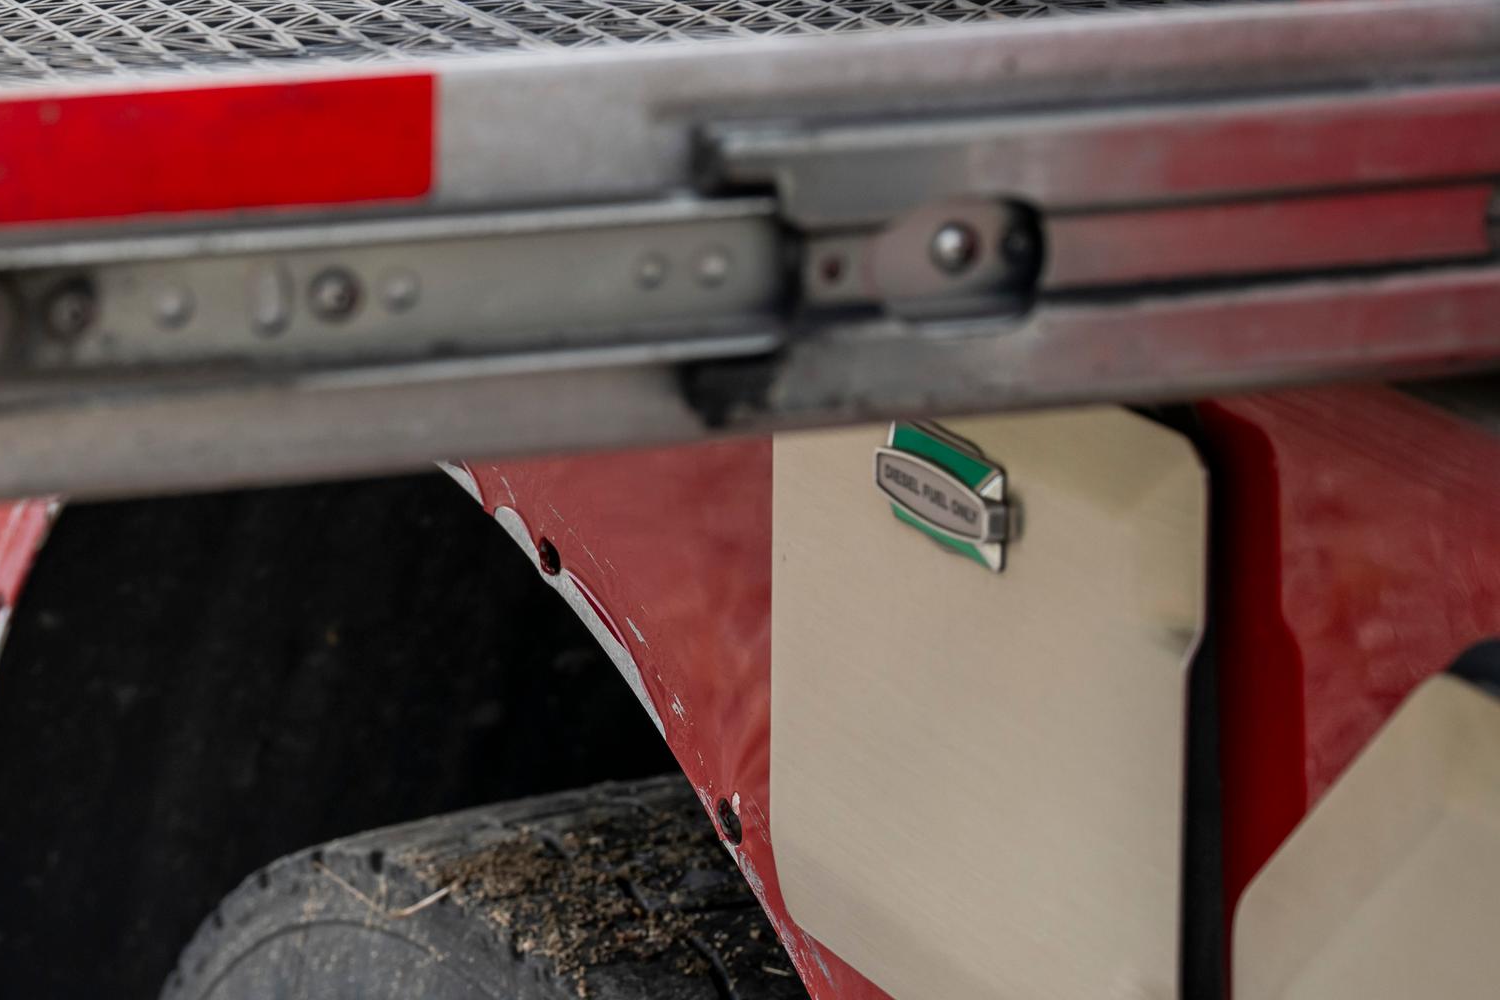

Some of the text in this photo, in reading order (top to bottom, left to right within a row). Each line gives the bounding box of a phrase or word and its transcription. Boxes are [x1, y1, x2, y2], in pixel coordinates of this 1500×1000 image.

[884, 463, 979, 524] DIESEL FUEL ONLY
